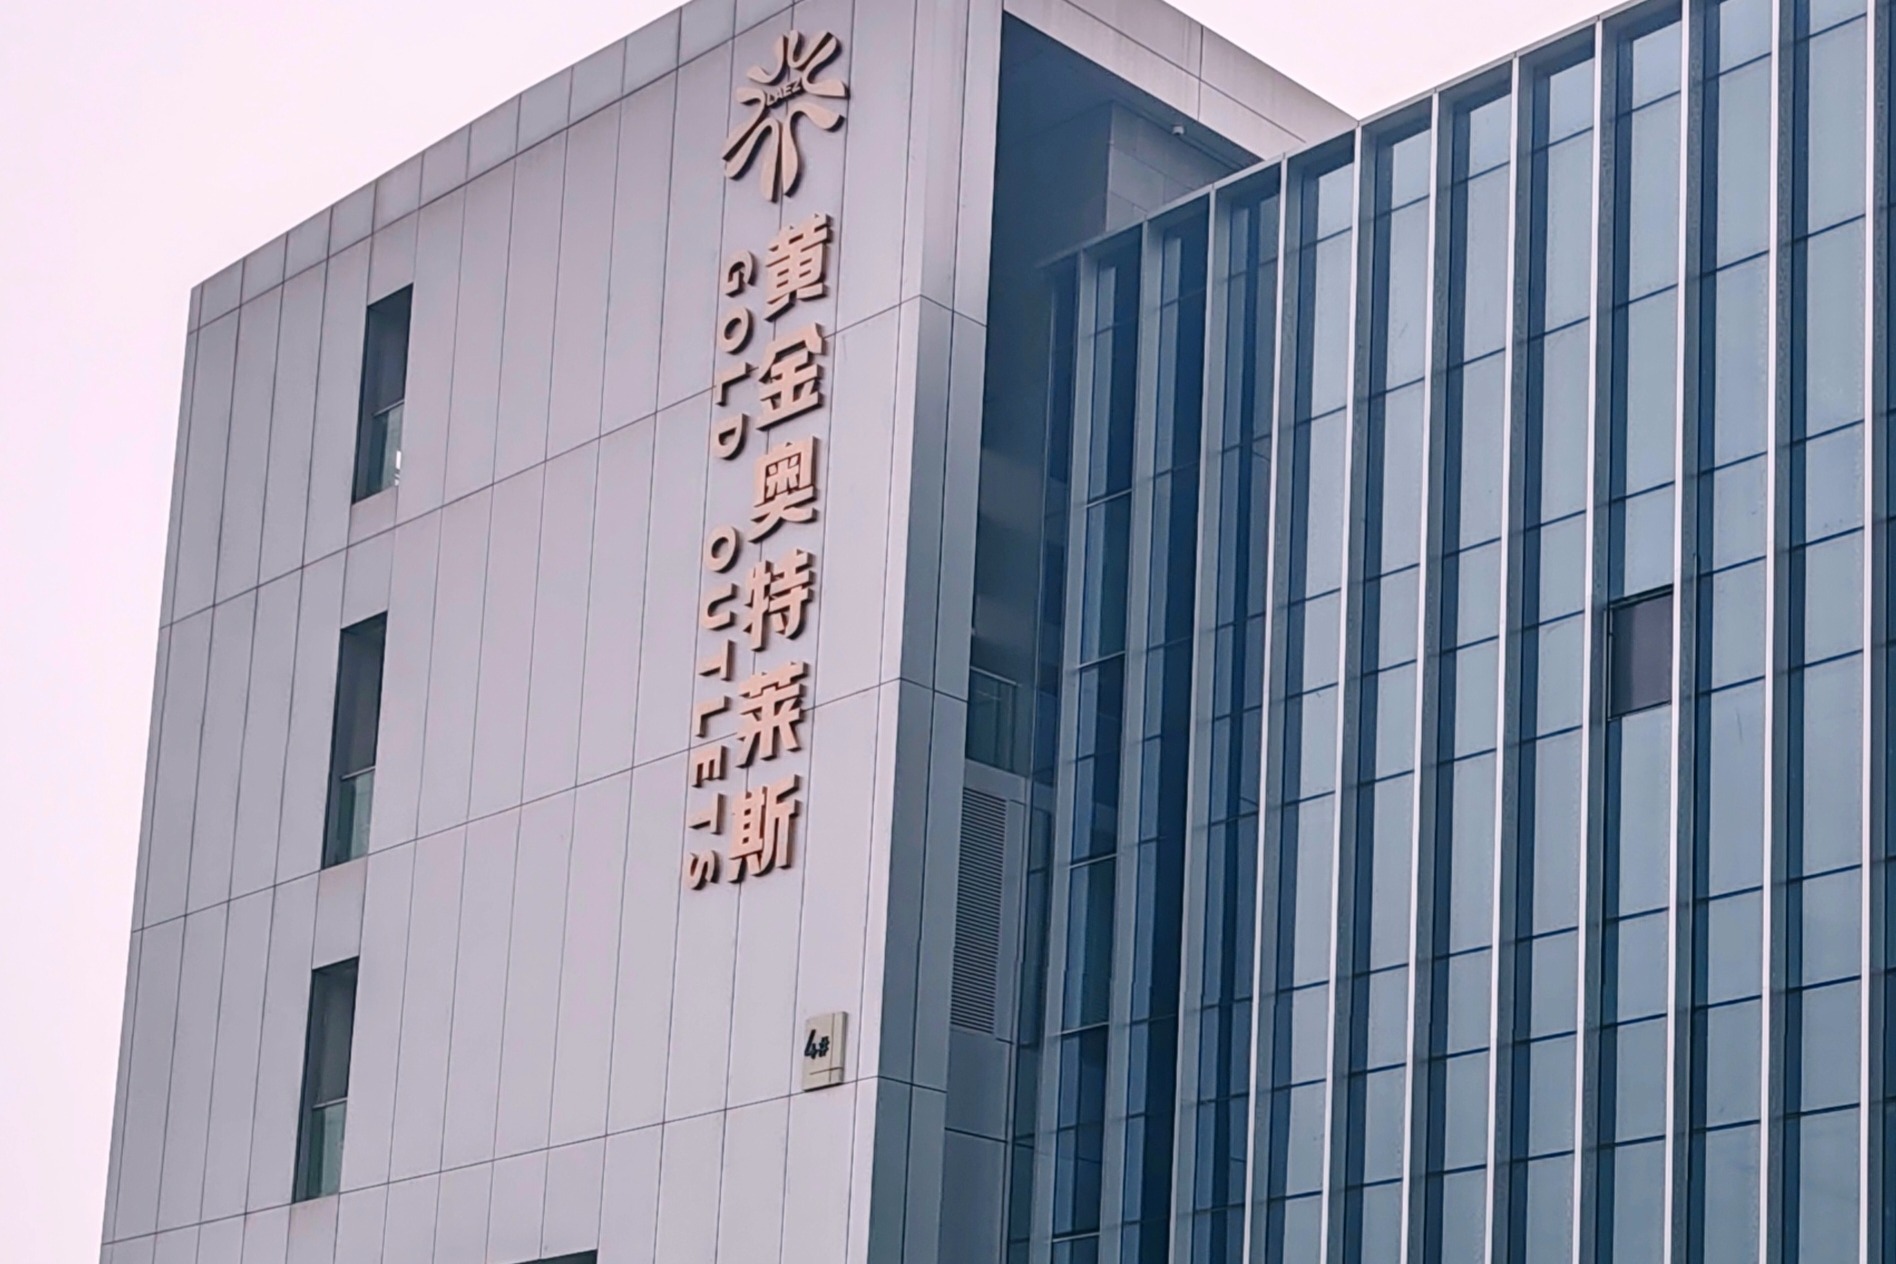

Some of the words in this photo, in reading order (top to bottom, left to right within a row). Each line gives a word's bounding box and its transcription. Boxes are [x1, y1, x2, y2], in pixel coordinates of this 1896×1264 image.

[766, 81, 806, 108] LAEZ
[711, 250, 757, 460] GOLD
[728, 212, 831, 883] 黄金奥特莱斯
[687, 524, 739, 890] OUTLETS
